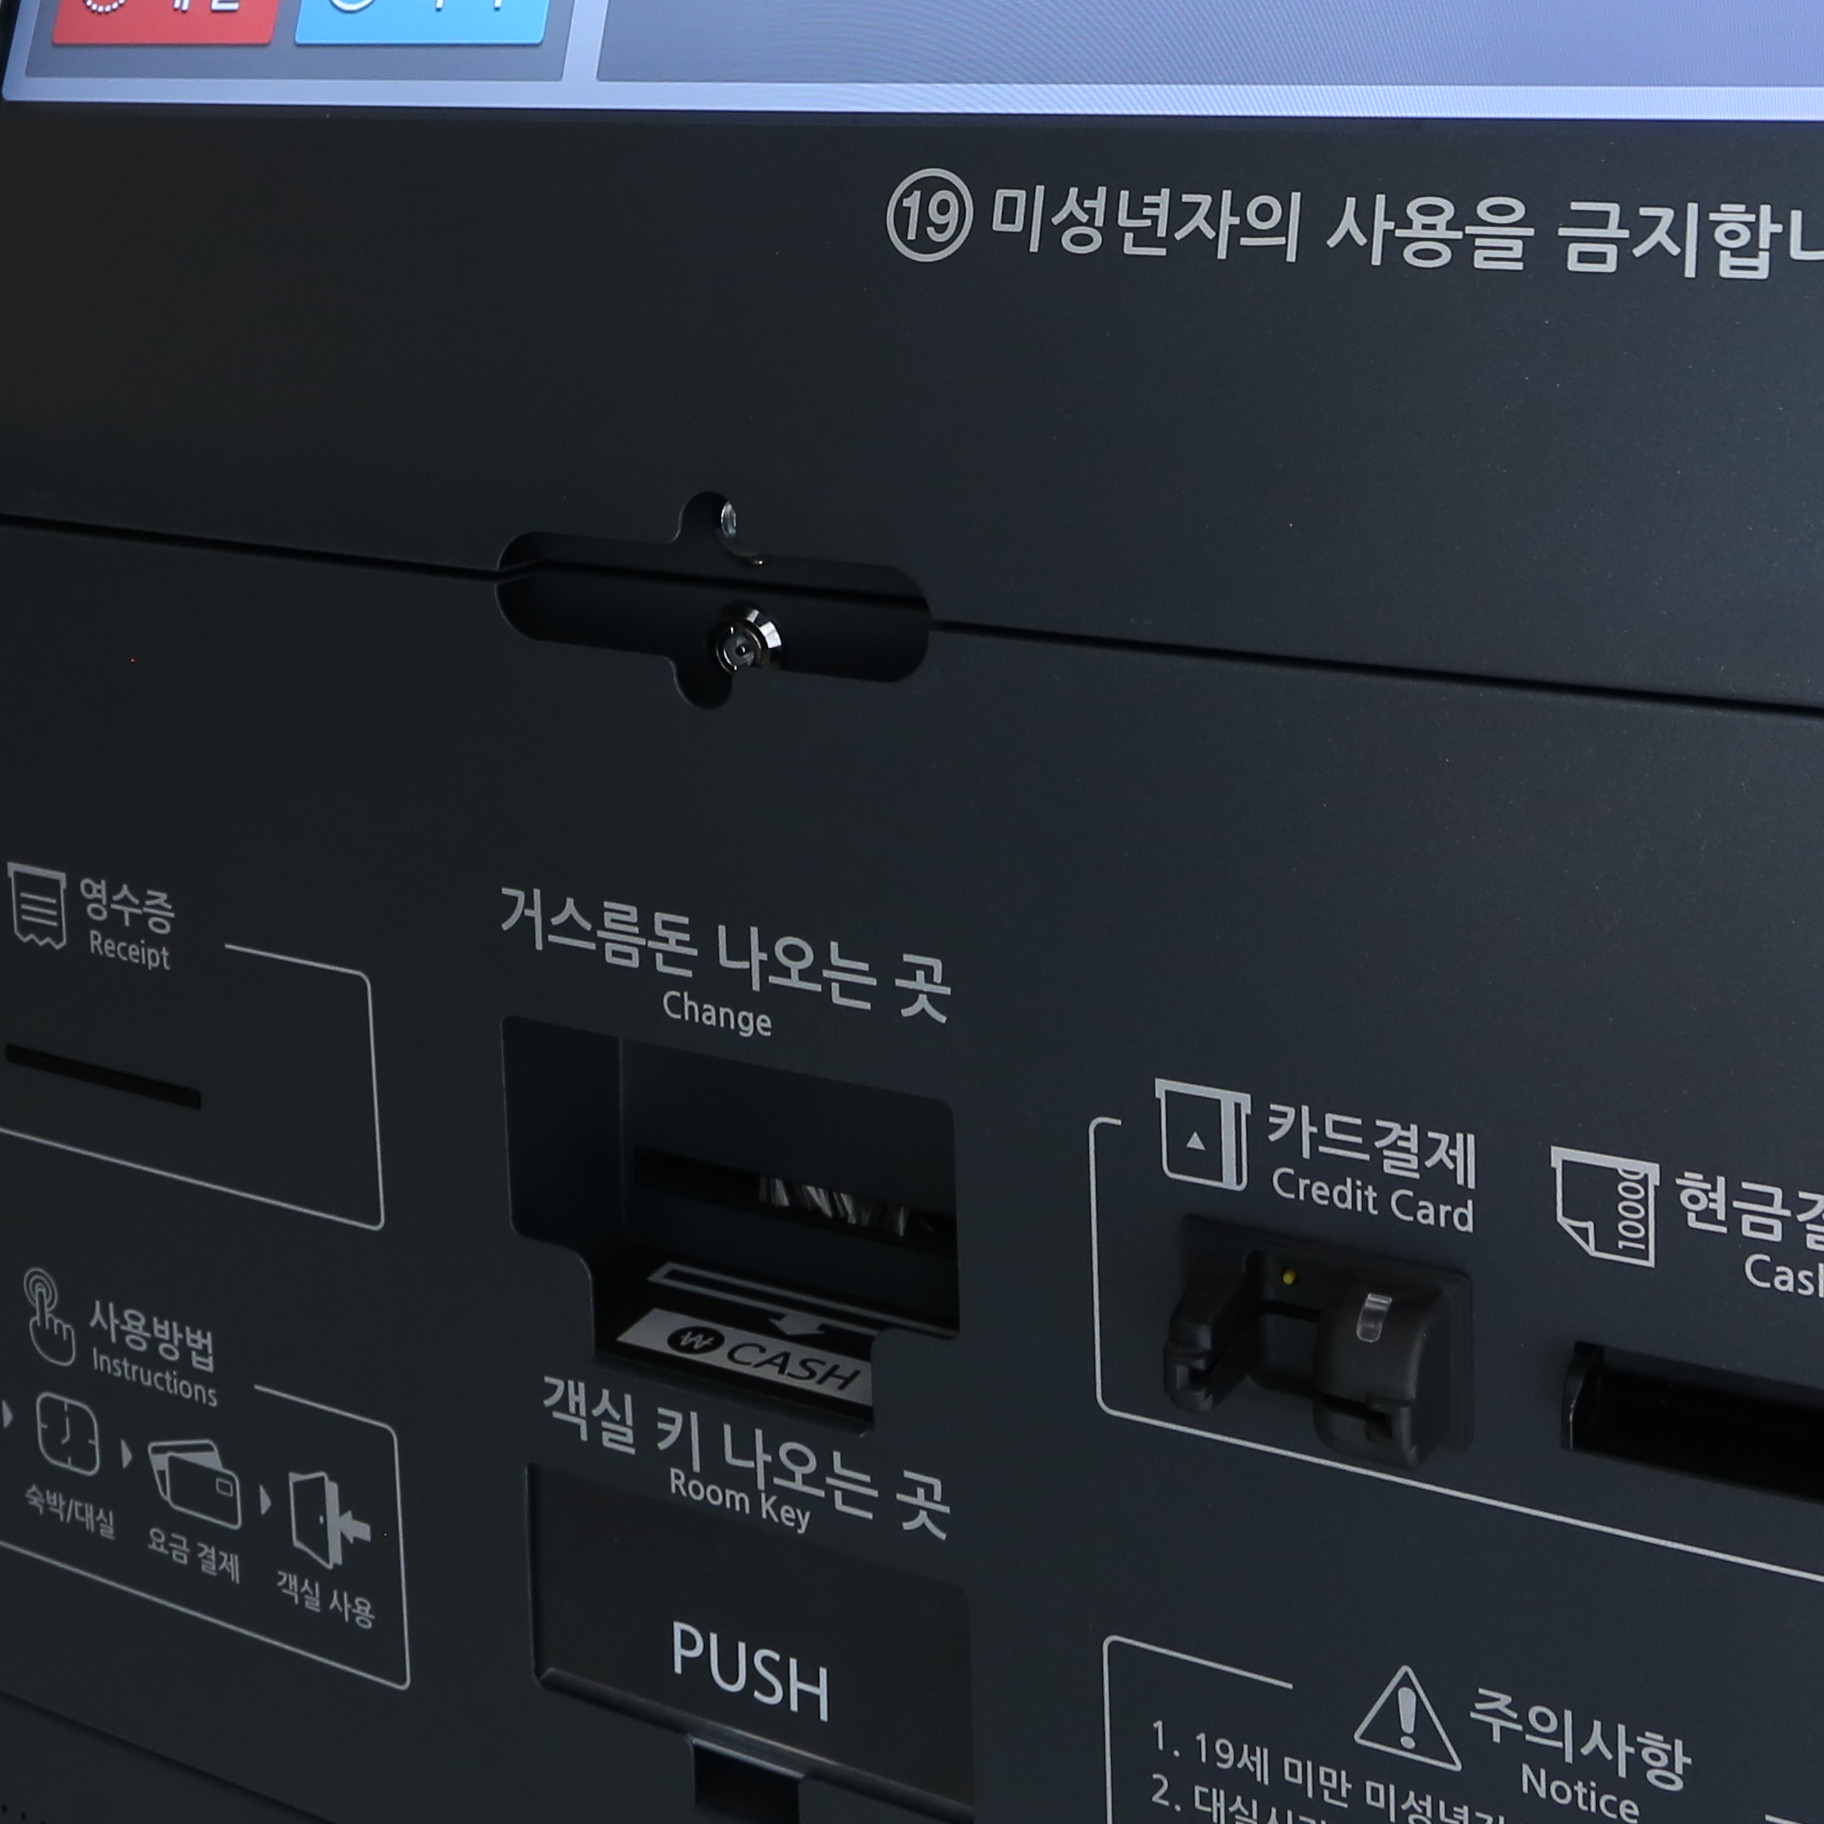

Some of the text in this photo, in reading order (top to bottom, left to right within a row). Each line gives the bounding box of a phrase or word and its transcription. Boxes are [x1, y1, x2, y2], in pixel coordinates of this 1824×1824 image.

[991, 183, 1300, 263] 미성년자의
[1325, 194, 1536, 273] 사용을
[78, 877, 176, 935] 영수증
[88, 929, 172, 971] Receipt
[500, 886, 952, 1024] 거스름돈 나오는 곳
[662, 989, 773, 1037] Change
[1267, 1101, 1477, 1190] 카드결제
[1270, 1166, 1475, 1234] Credit Card
[89, 1299, 215, 1373] 사용방법
[726, 1342, 862, 1391] CASH
[92, 1346, 218, 1407] Instructions
[542, 1374, 951, 1541] 객실 키 나오는 곳
[25, 1483, 115, 1540] 숙박/대실
[669, 1466, 811, 1535] Room Key
[147, 1527, 240, 1585] 요금 결제
[277, 1570, 376, 1630] 객실 사용
[672, 1620, 830, 1723] PUSH
[1151, 1719, 1181, 1758] 1.
[1195, 1732, 1270, 1786] 19세
[1283, 1755, 1354, 1809] 미만
[1469, 1686, 1693, 1793] 주의사항
[1151, 1773, 1182, 1813] 2.
[1521, 1762, 1640, 1823] Notice
